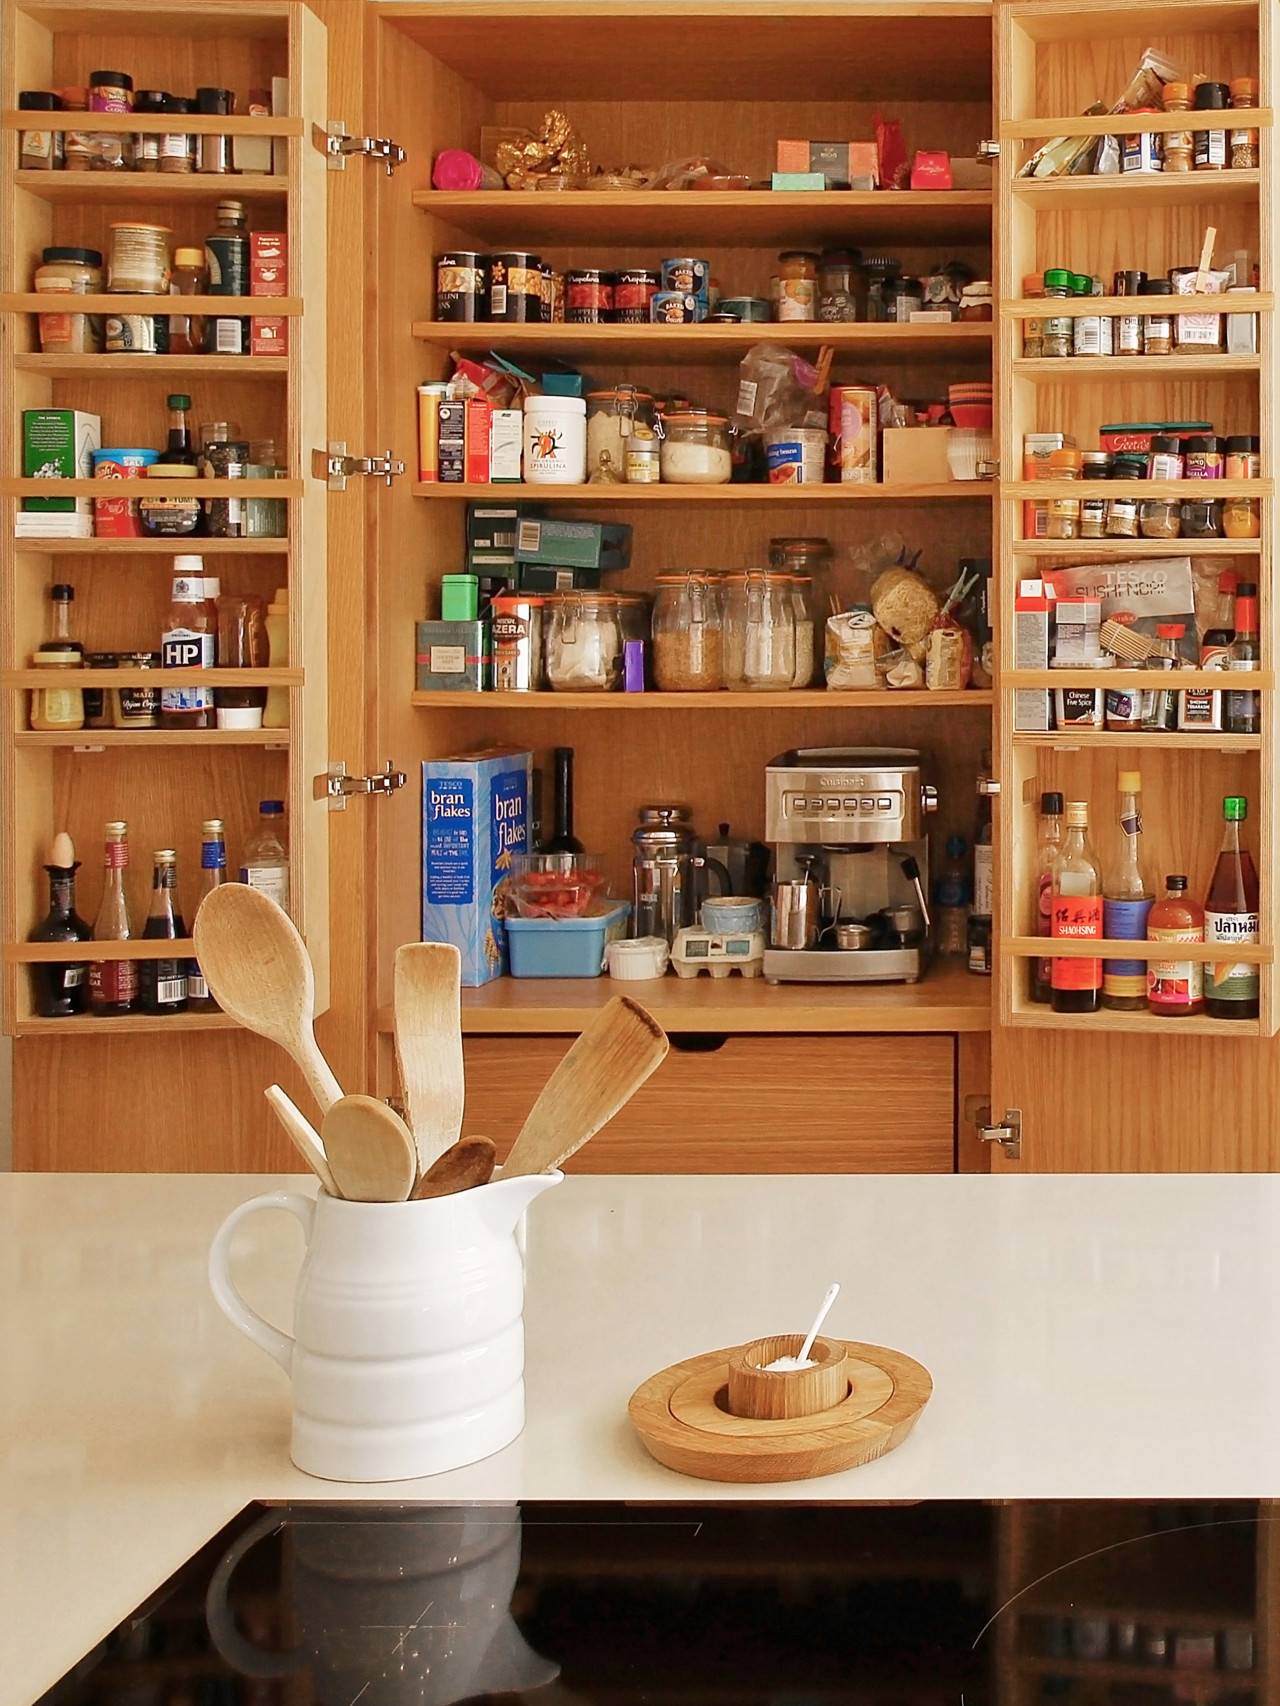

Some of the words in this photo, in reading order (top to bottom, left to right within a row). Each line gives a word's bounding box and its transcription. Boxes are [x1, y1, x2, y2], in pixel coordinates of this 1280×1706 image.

[620, 273, 656, 285] Napolina
[674, 269, 694, 277] BAKED
[1113, 435, 1150, 451] Geeta's
[530, 462, 567, 470] SPIRULINA
[1101, 569, 1168, 586] TESCO
[492, 624, 526, 635] AZERA
[165, 643, 199, 665] HP
[1068, 691, 1090, 699] Chinese
[1079, 699, 1093, 707] Spice
[431, 790, 465, 805] bran
[433, 804, 471, 820] flakes
[495, 793, 522, 821] bran
[497, 819, 526, 856] flakes
[1058, 925, 1096, 935] SHAOHSING
